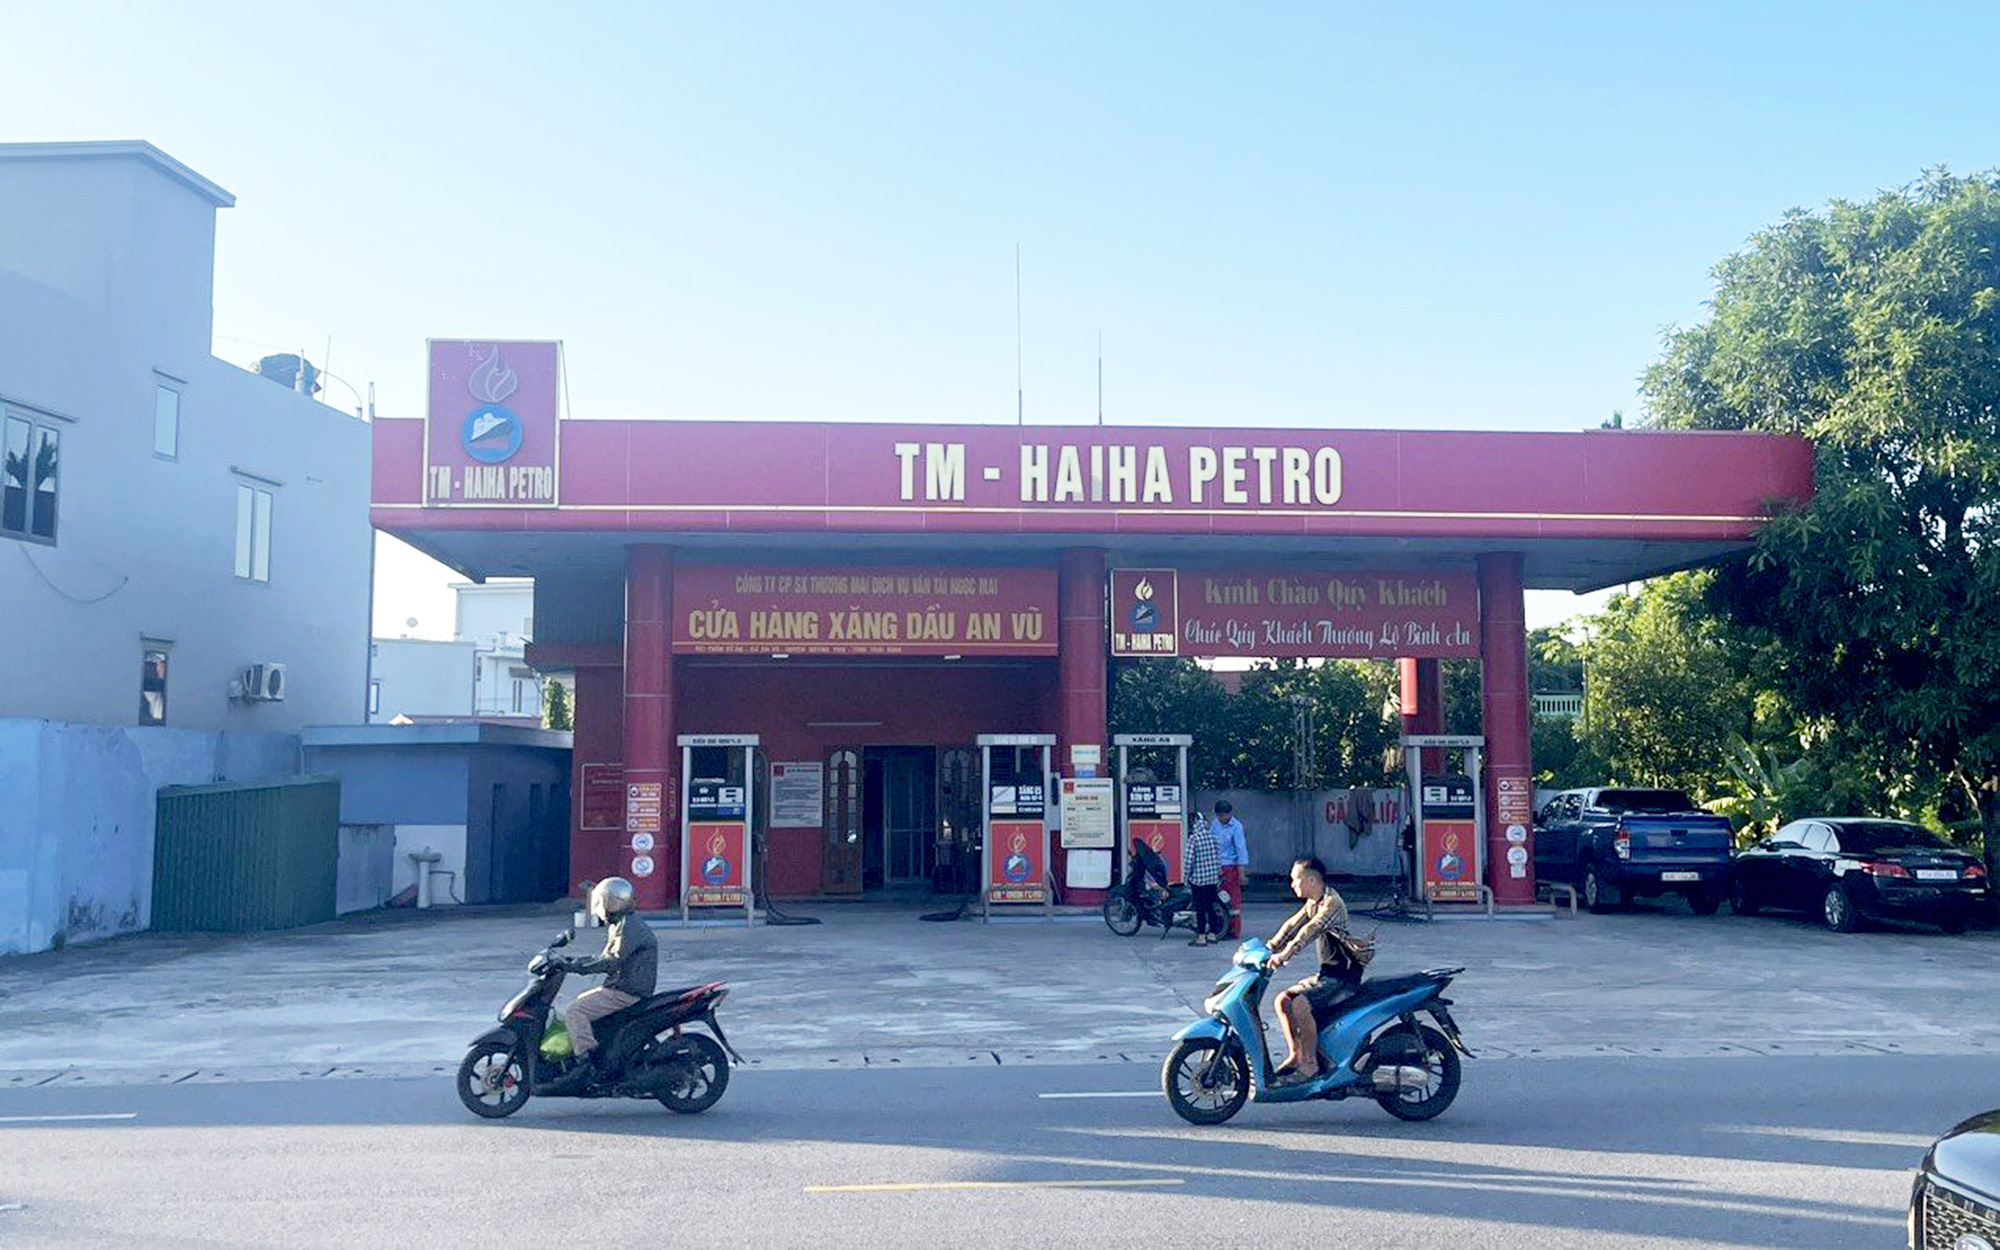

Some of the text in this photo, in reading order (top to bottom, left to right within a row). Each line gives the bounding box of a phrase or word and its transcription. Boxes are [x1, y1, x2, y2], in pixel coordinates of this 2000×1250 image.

[430, 466, 451, 499] TM
[464, 466, 505, 499] HAIHA
[509, 466, 552, 499] PETRO
[894, 442, 1342, 506] TM - HAIHA PETRO
[1379, 579, 1447, 606] Khách
[689, 600, 1043, 640] CỬA HÀNG XĂNG DẦU AN VŨ
[1185, 618, 1221, 644] Chúc
[1226, 618, 1256, 650] Quý
[1261, 620, 1312, 645] Khách
